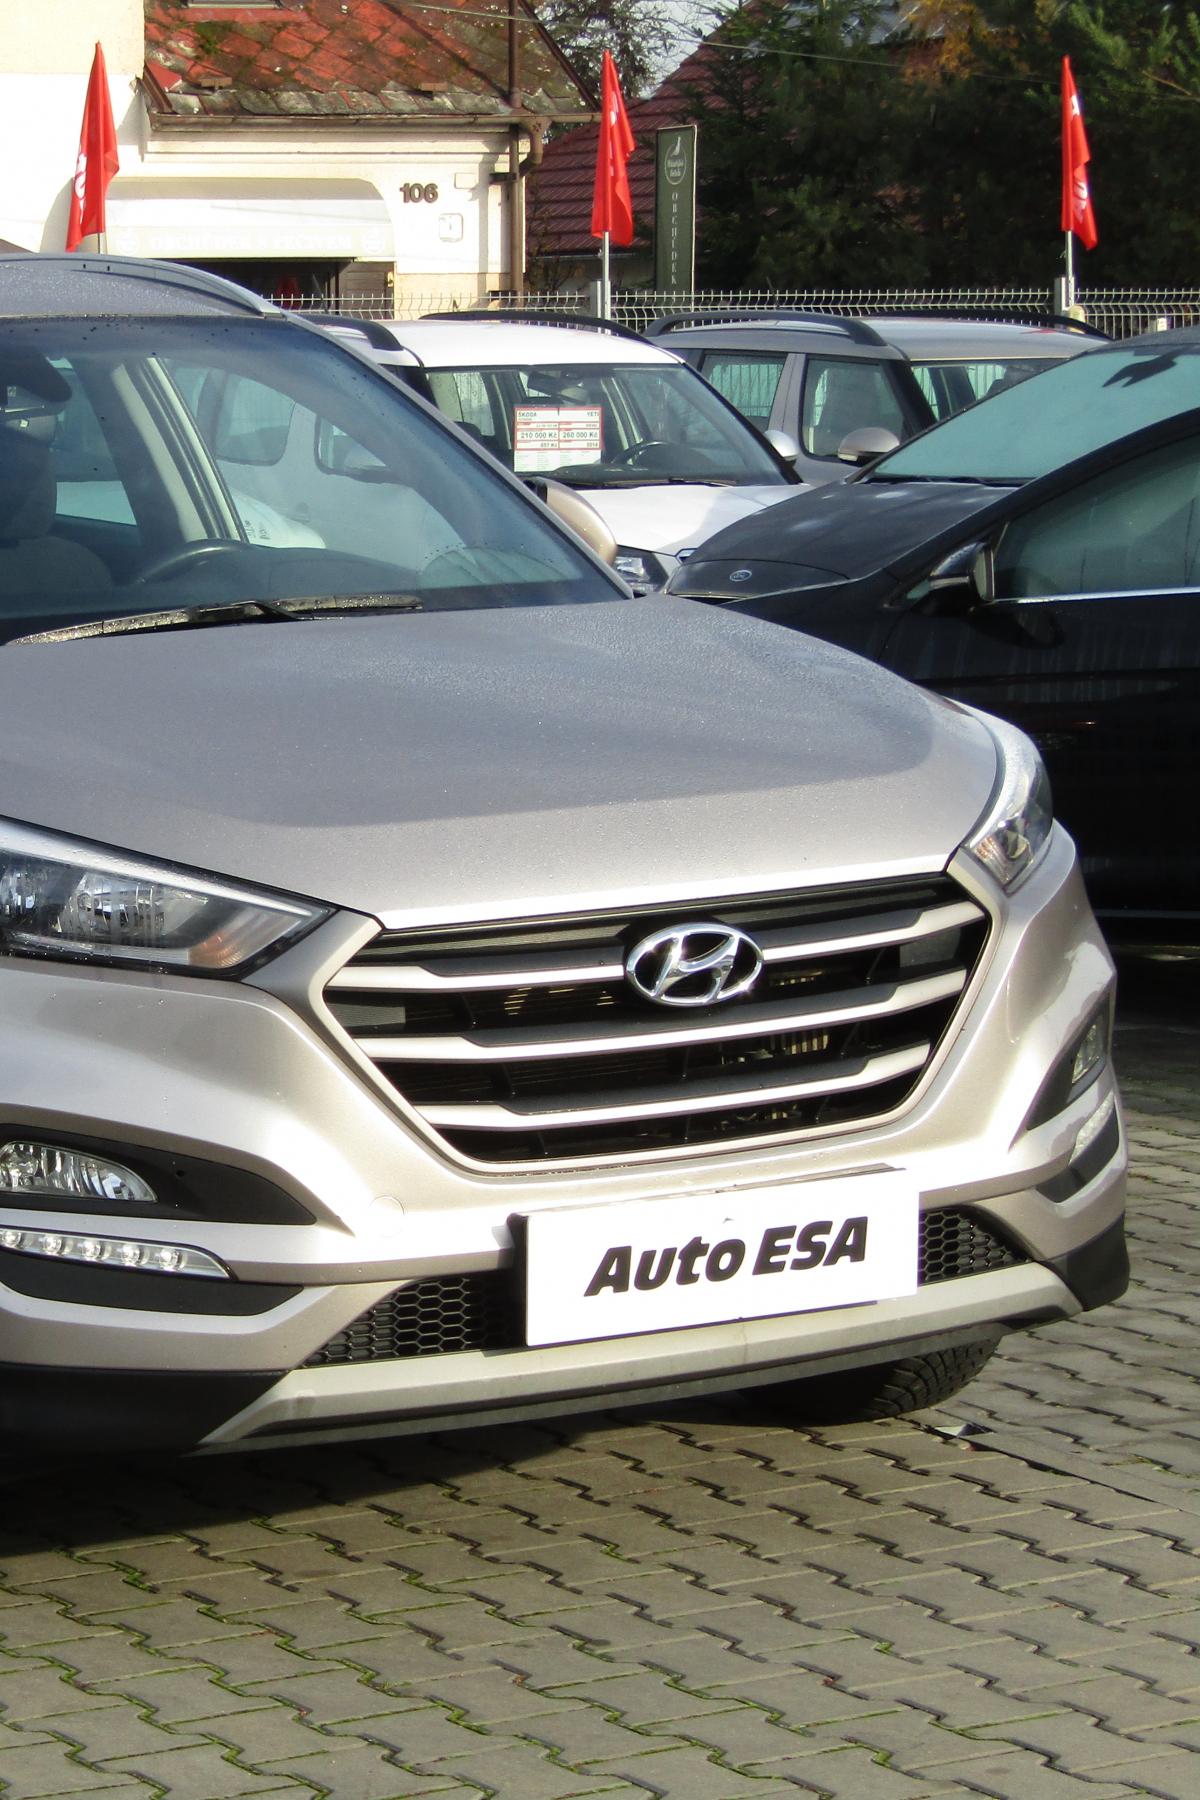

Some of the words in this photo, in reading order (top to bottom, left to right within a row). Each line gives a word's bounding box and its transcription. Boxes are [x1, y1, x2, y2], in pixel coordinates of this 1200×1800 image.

[399, 183, 438, 203] 106
[584, 1236, 746, 1297] Auto
[752, 1216, 869, 1276] ESA
